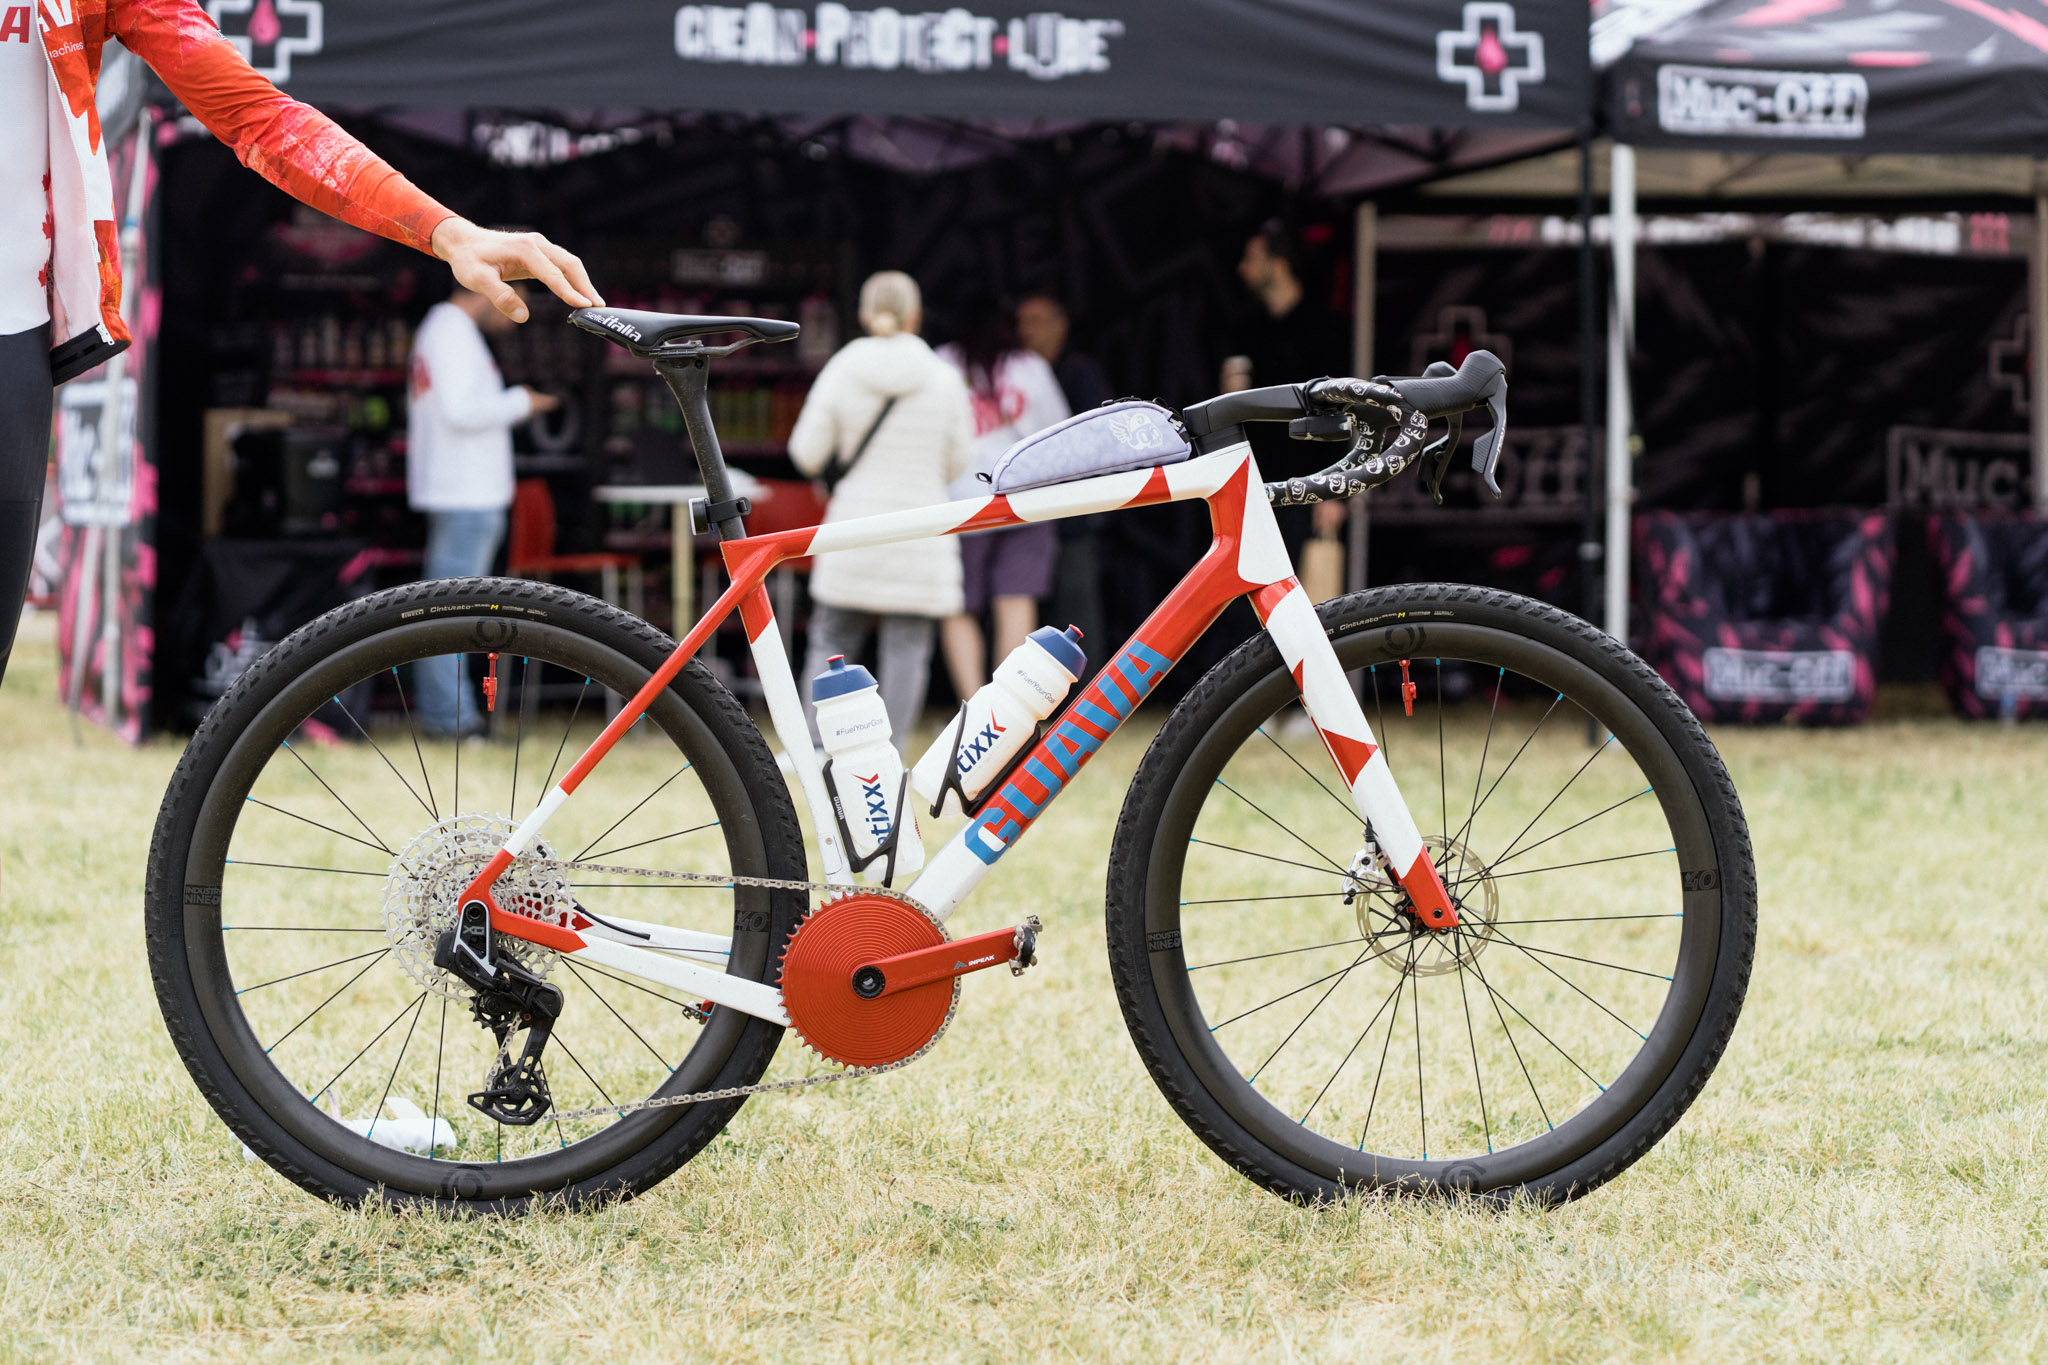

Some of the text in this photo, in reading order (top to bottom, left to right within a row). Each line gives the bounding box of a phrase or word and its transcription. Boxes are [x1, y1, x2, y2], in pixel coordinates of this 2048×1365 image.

[401, 608, 425, 619] PIRELLI
[957, 722, 1001, 781] tixx
[965, 640, 1174, 865] GUAVA
[968, 954, 996, 967] INPEAK
